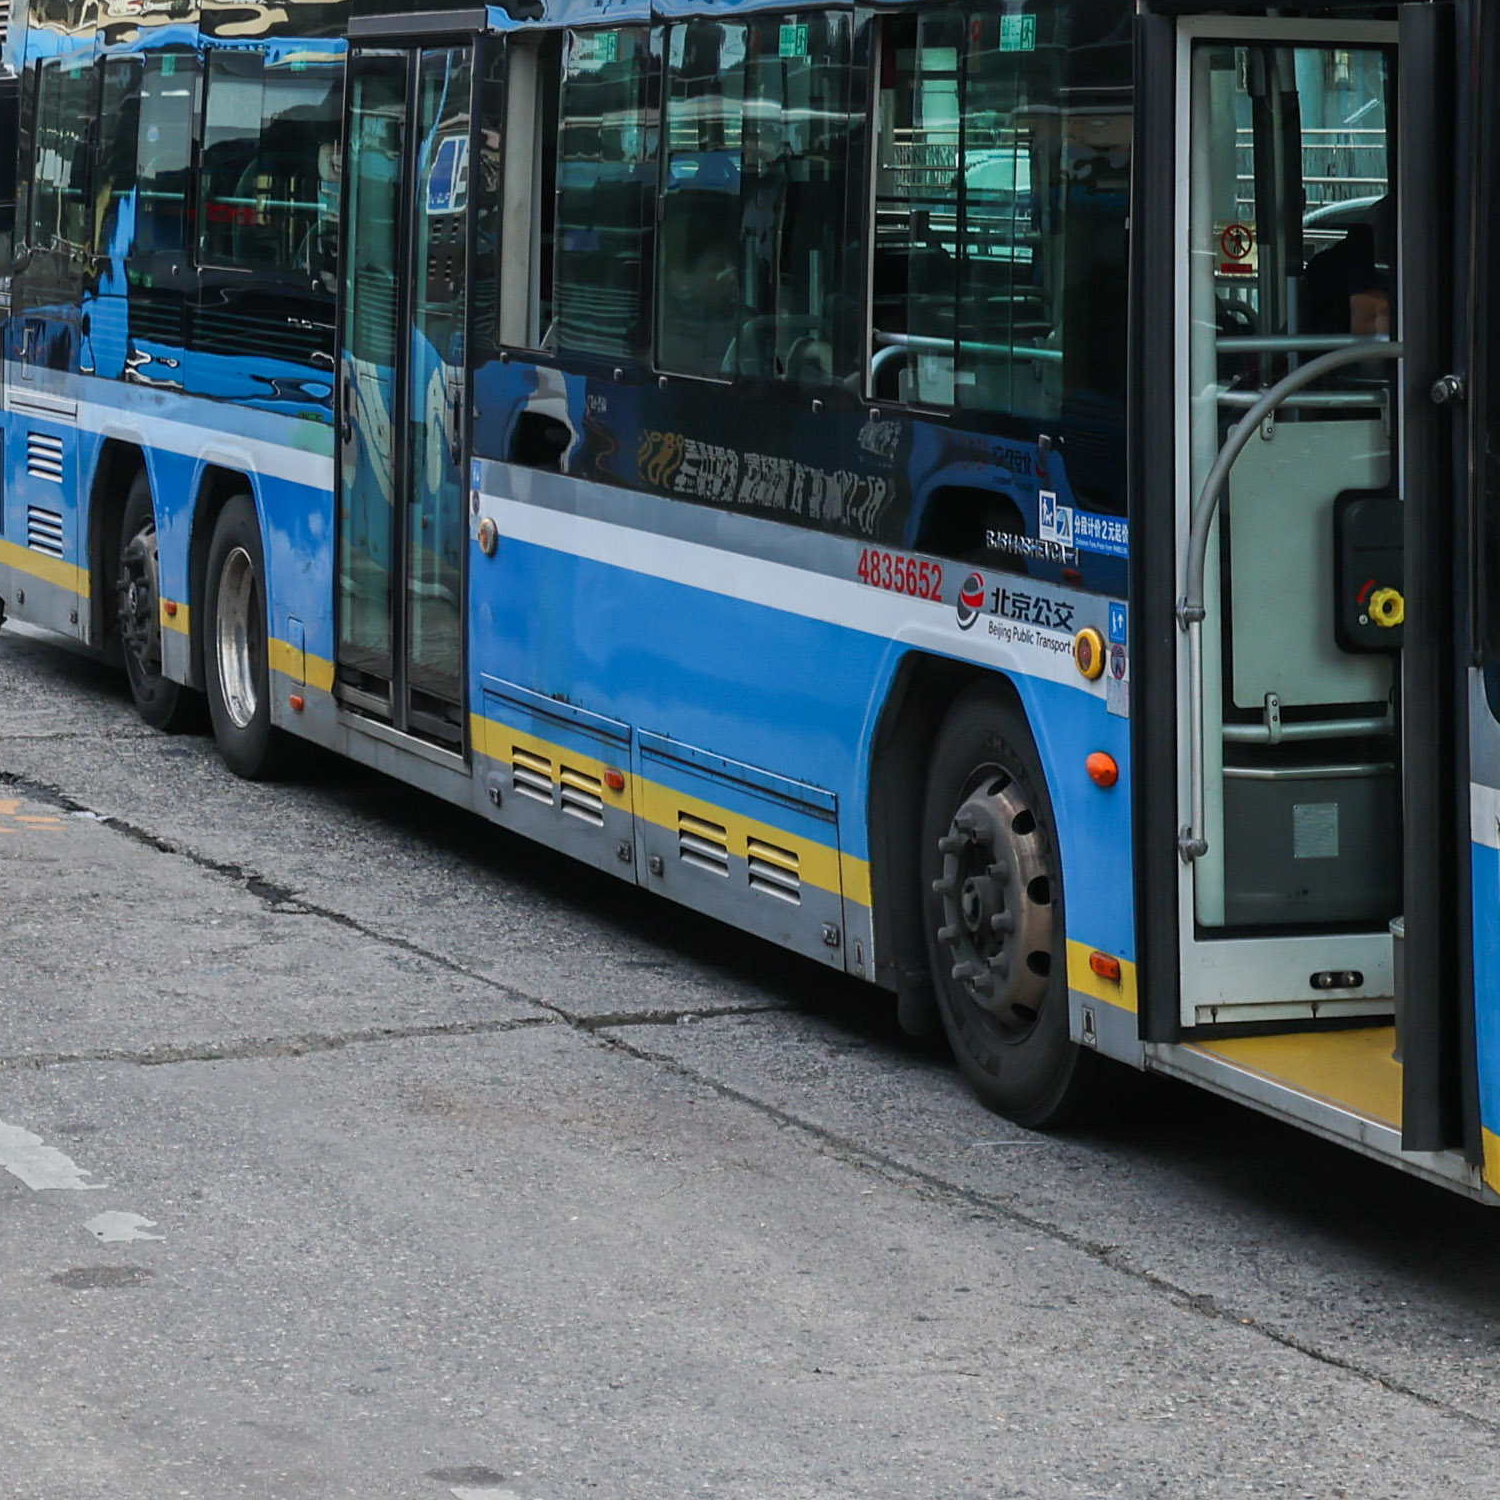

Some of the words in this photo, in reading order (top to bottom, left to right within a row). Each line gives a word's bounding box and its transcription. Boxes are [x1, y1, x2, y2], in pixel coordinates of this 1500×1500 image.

[857, 548, 943, 602] 4835652
[990, 586, 1076, 631] 北京公交
[988, 619, 1012, 643] Beijing
[1012, 626, 1035, 645] Public
[1035, 631, 1072, 655] Transport
